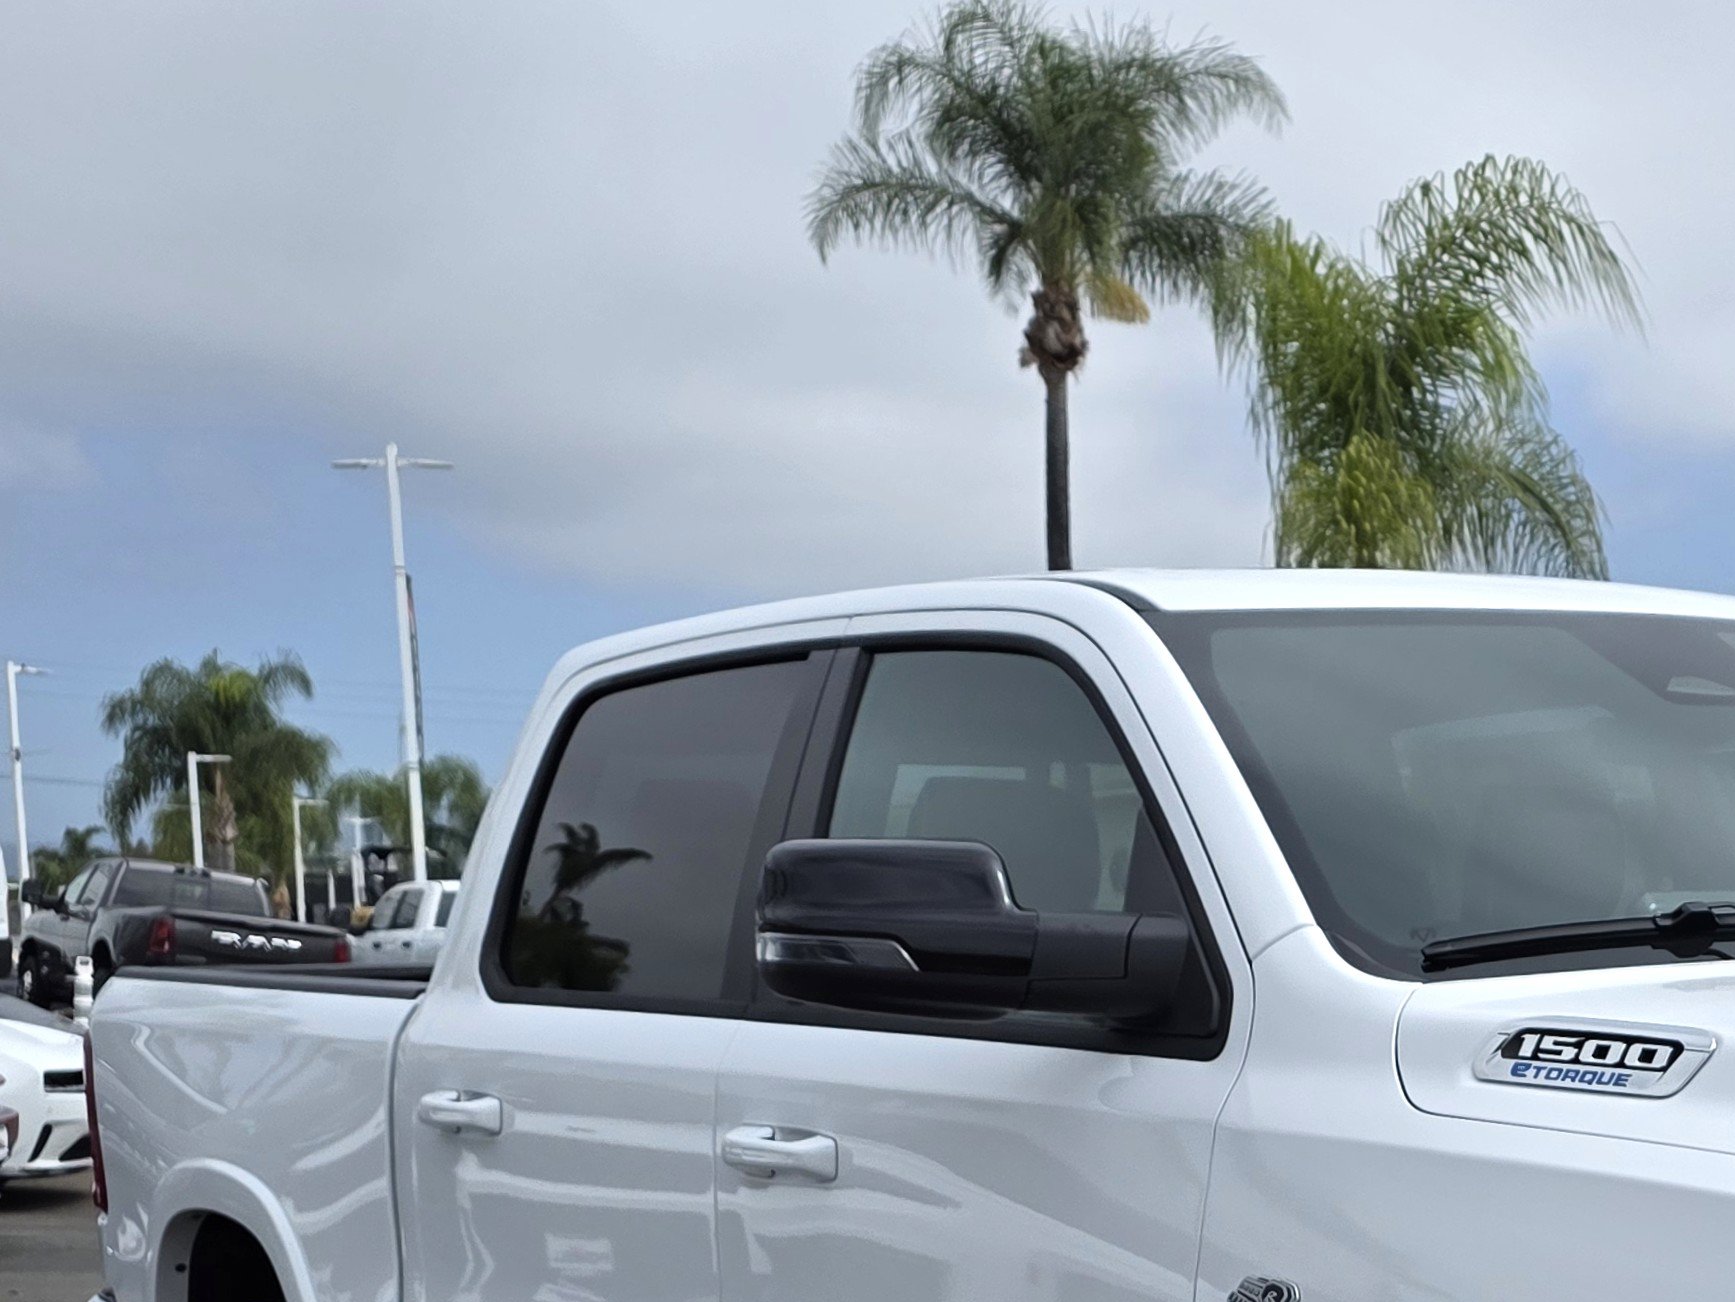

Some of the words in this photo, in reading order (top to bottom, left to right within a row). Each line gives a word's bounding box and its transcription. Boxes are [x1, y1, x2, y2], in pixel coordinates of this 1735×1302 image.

[210, 930, 302, 951] RAM
[1518, 1033, 1674, 1069] 1500
[1510, 1061, 1633, 1088] eTORQUE
